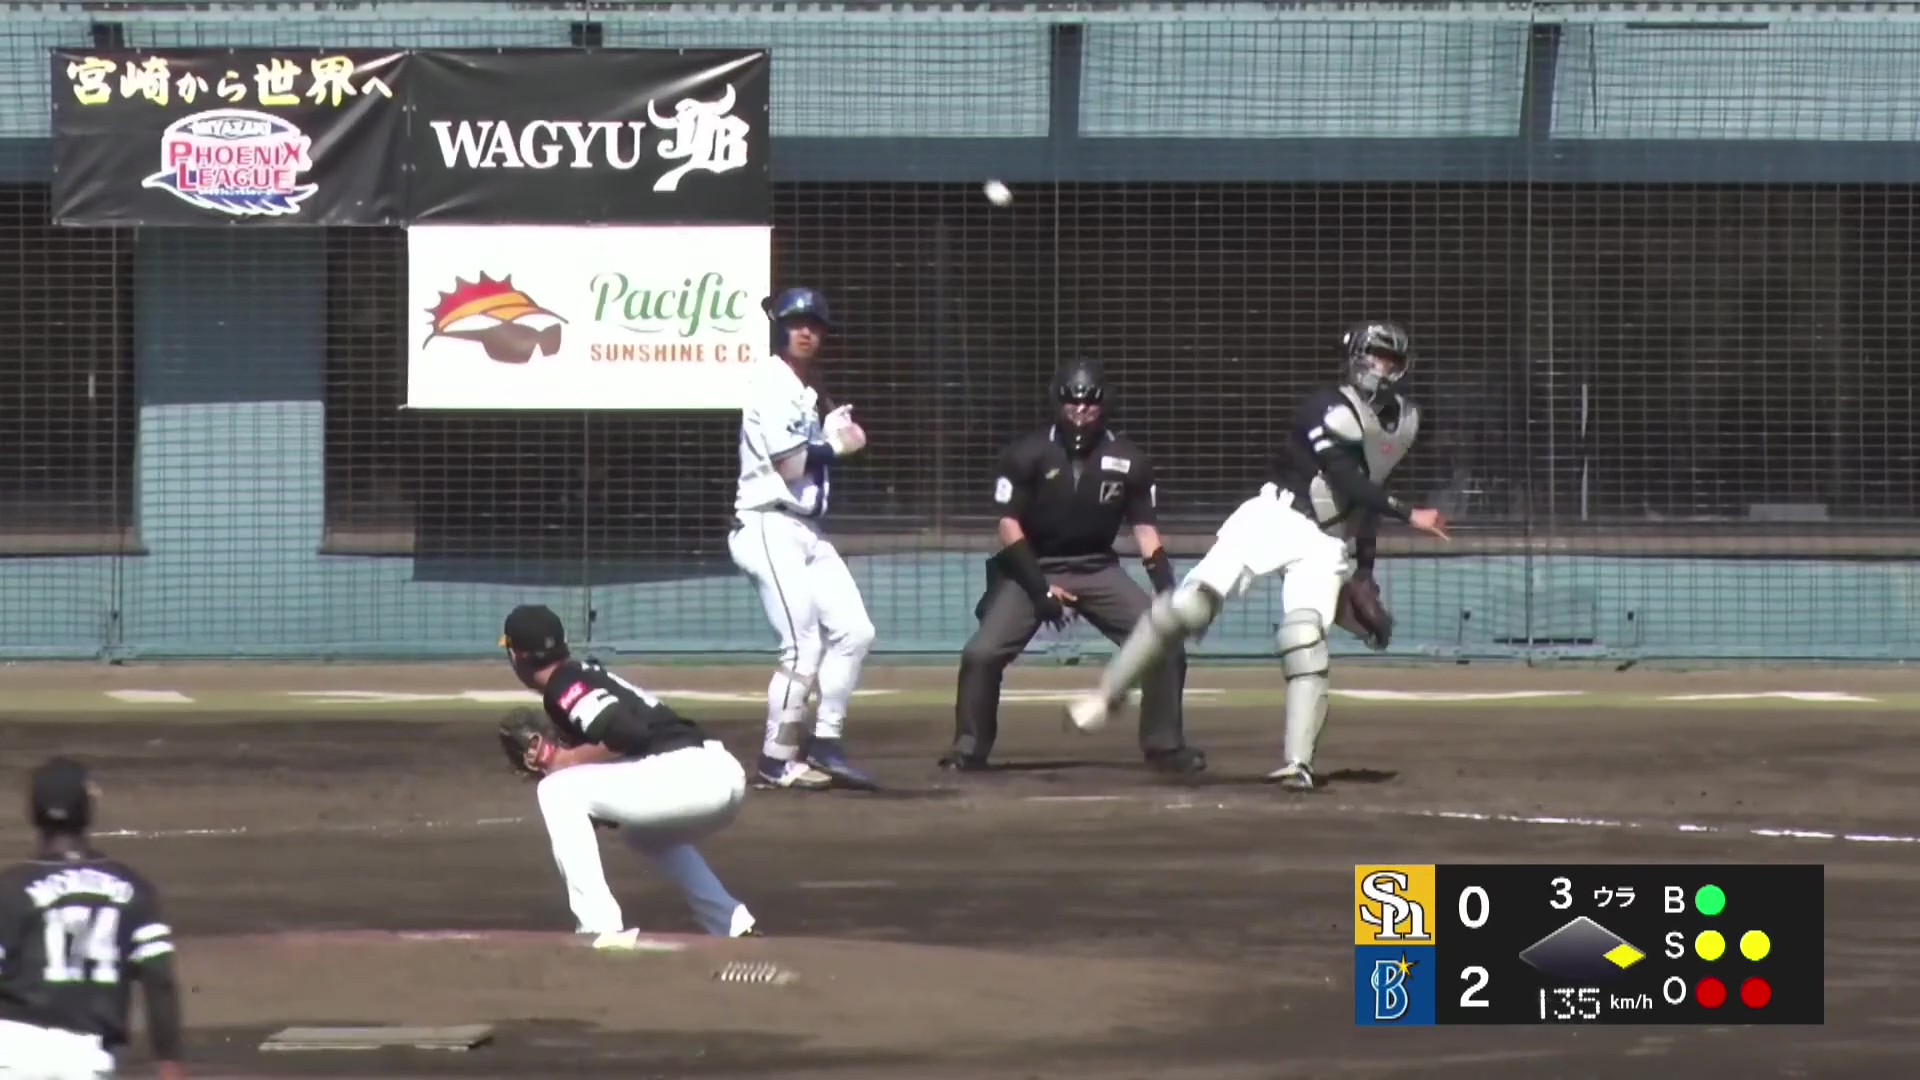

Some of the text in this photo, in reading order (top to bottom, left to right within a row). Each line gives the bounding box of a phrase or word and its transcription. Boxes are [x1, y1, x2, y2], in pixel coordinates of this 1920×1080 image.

[66, 56, 393, 107] 宮崎から世界へ
[169, 141, 302, 167] PHOENIX
[429, 120, 646, 170] WAGYU
[178, 163, 294, 194] LEAGUE
[590, 272, 748, 338] Pacific
[590, 343, 705, 362] SUNSHINE
